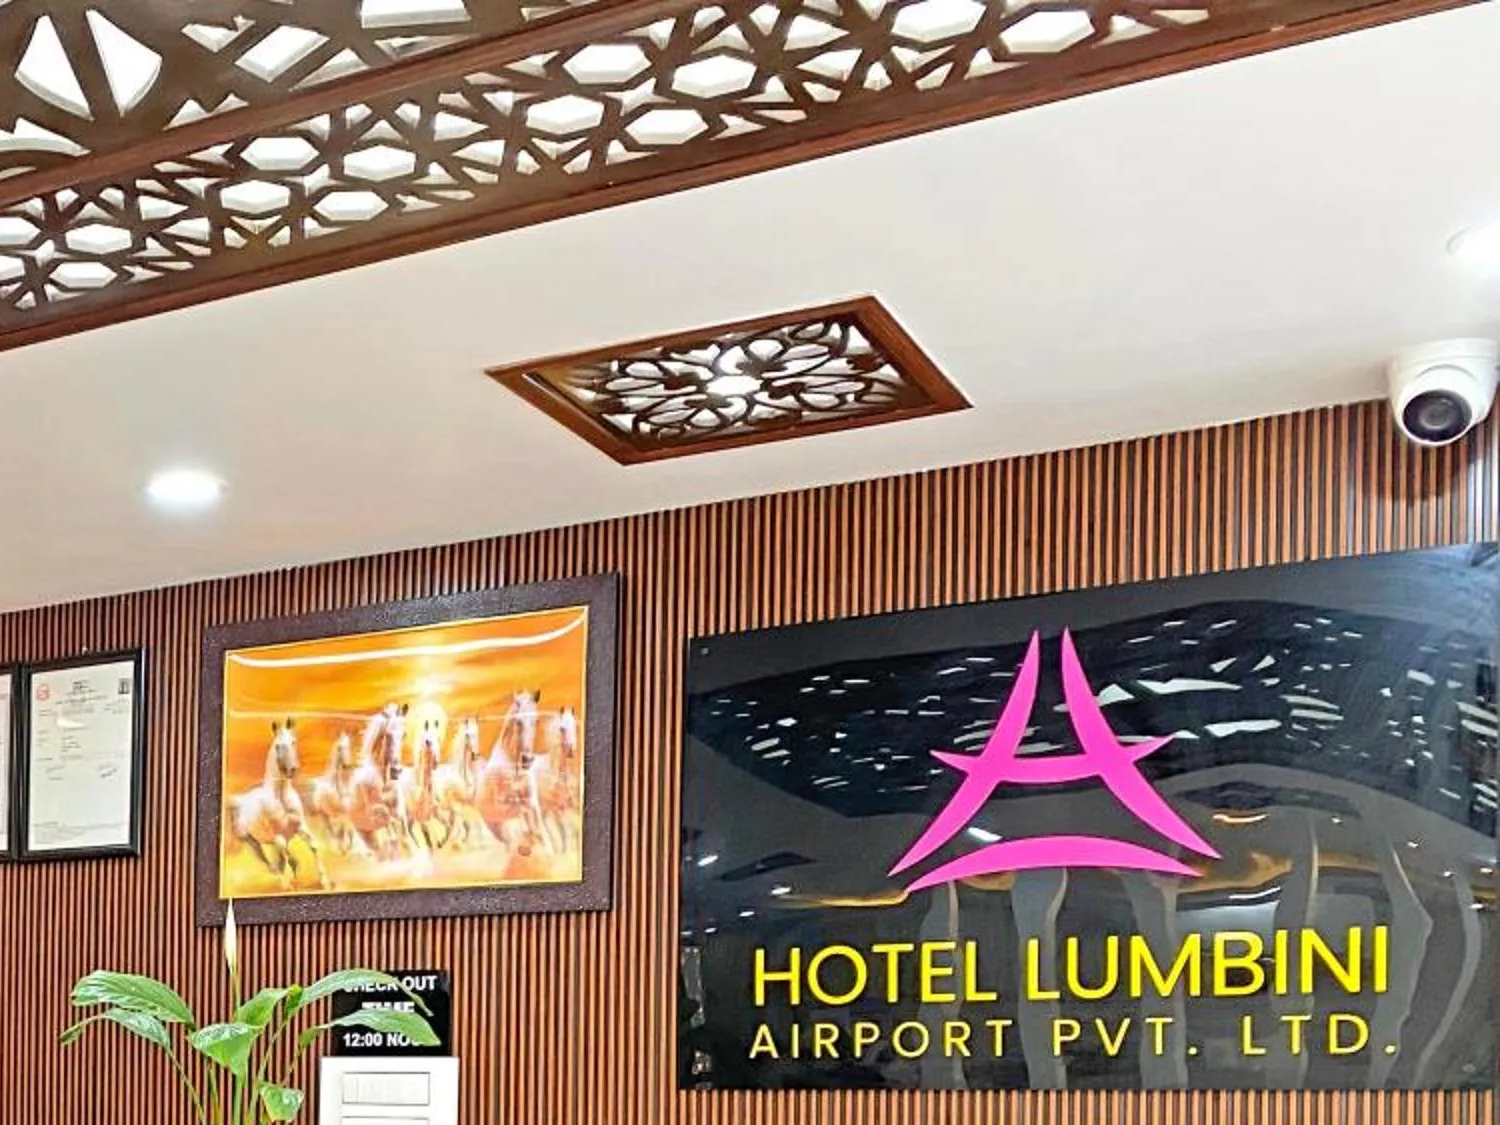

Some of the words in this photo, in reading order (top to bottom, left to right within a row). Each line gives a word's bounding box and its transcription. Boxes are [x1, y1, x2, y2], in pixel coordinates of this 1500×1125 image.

[754, 941, 998, 1007] HOTEL
[1027, 925, 1390, 1001] LUMBINI
[402, 975, 437, 991] OUT
[343, 1032, 383, 1047] 12:00
[749, 1017, 1013, 1060] AIRPORT
[1053, 1016, 1198, 1057] PVT.
[1241, 1013, 1400, 1057] LTD.
